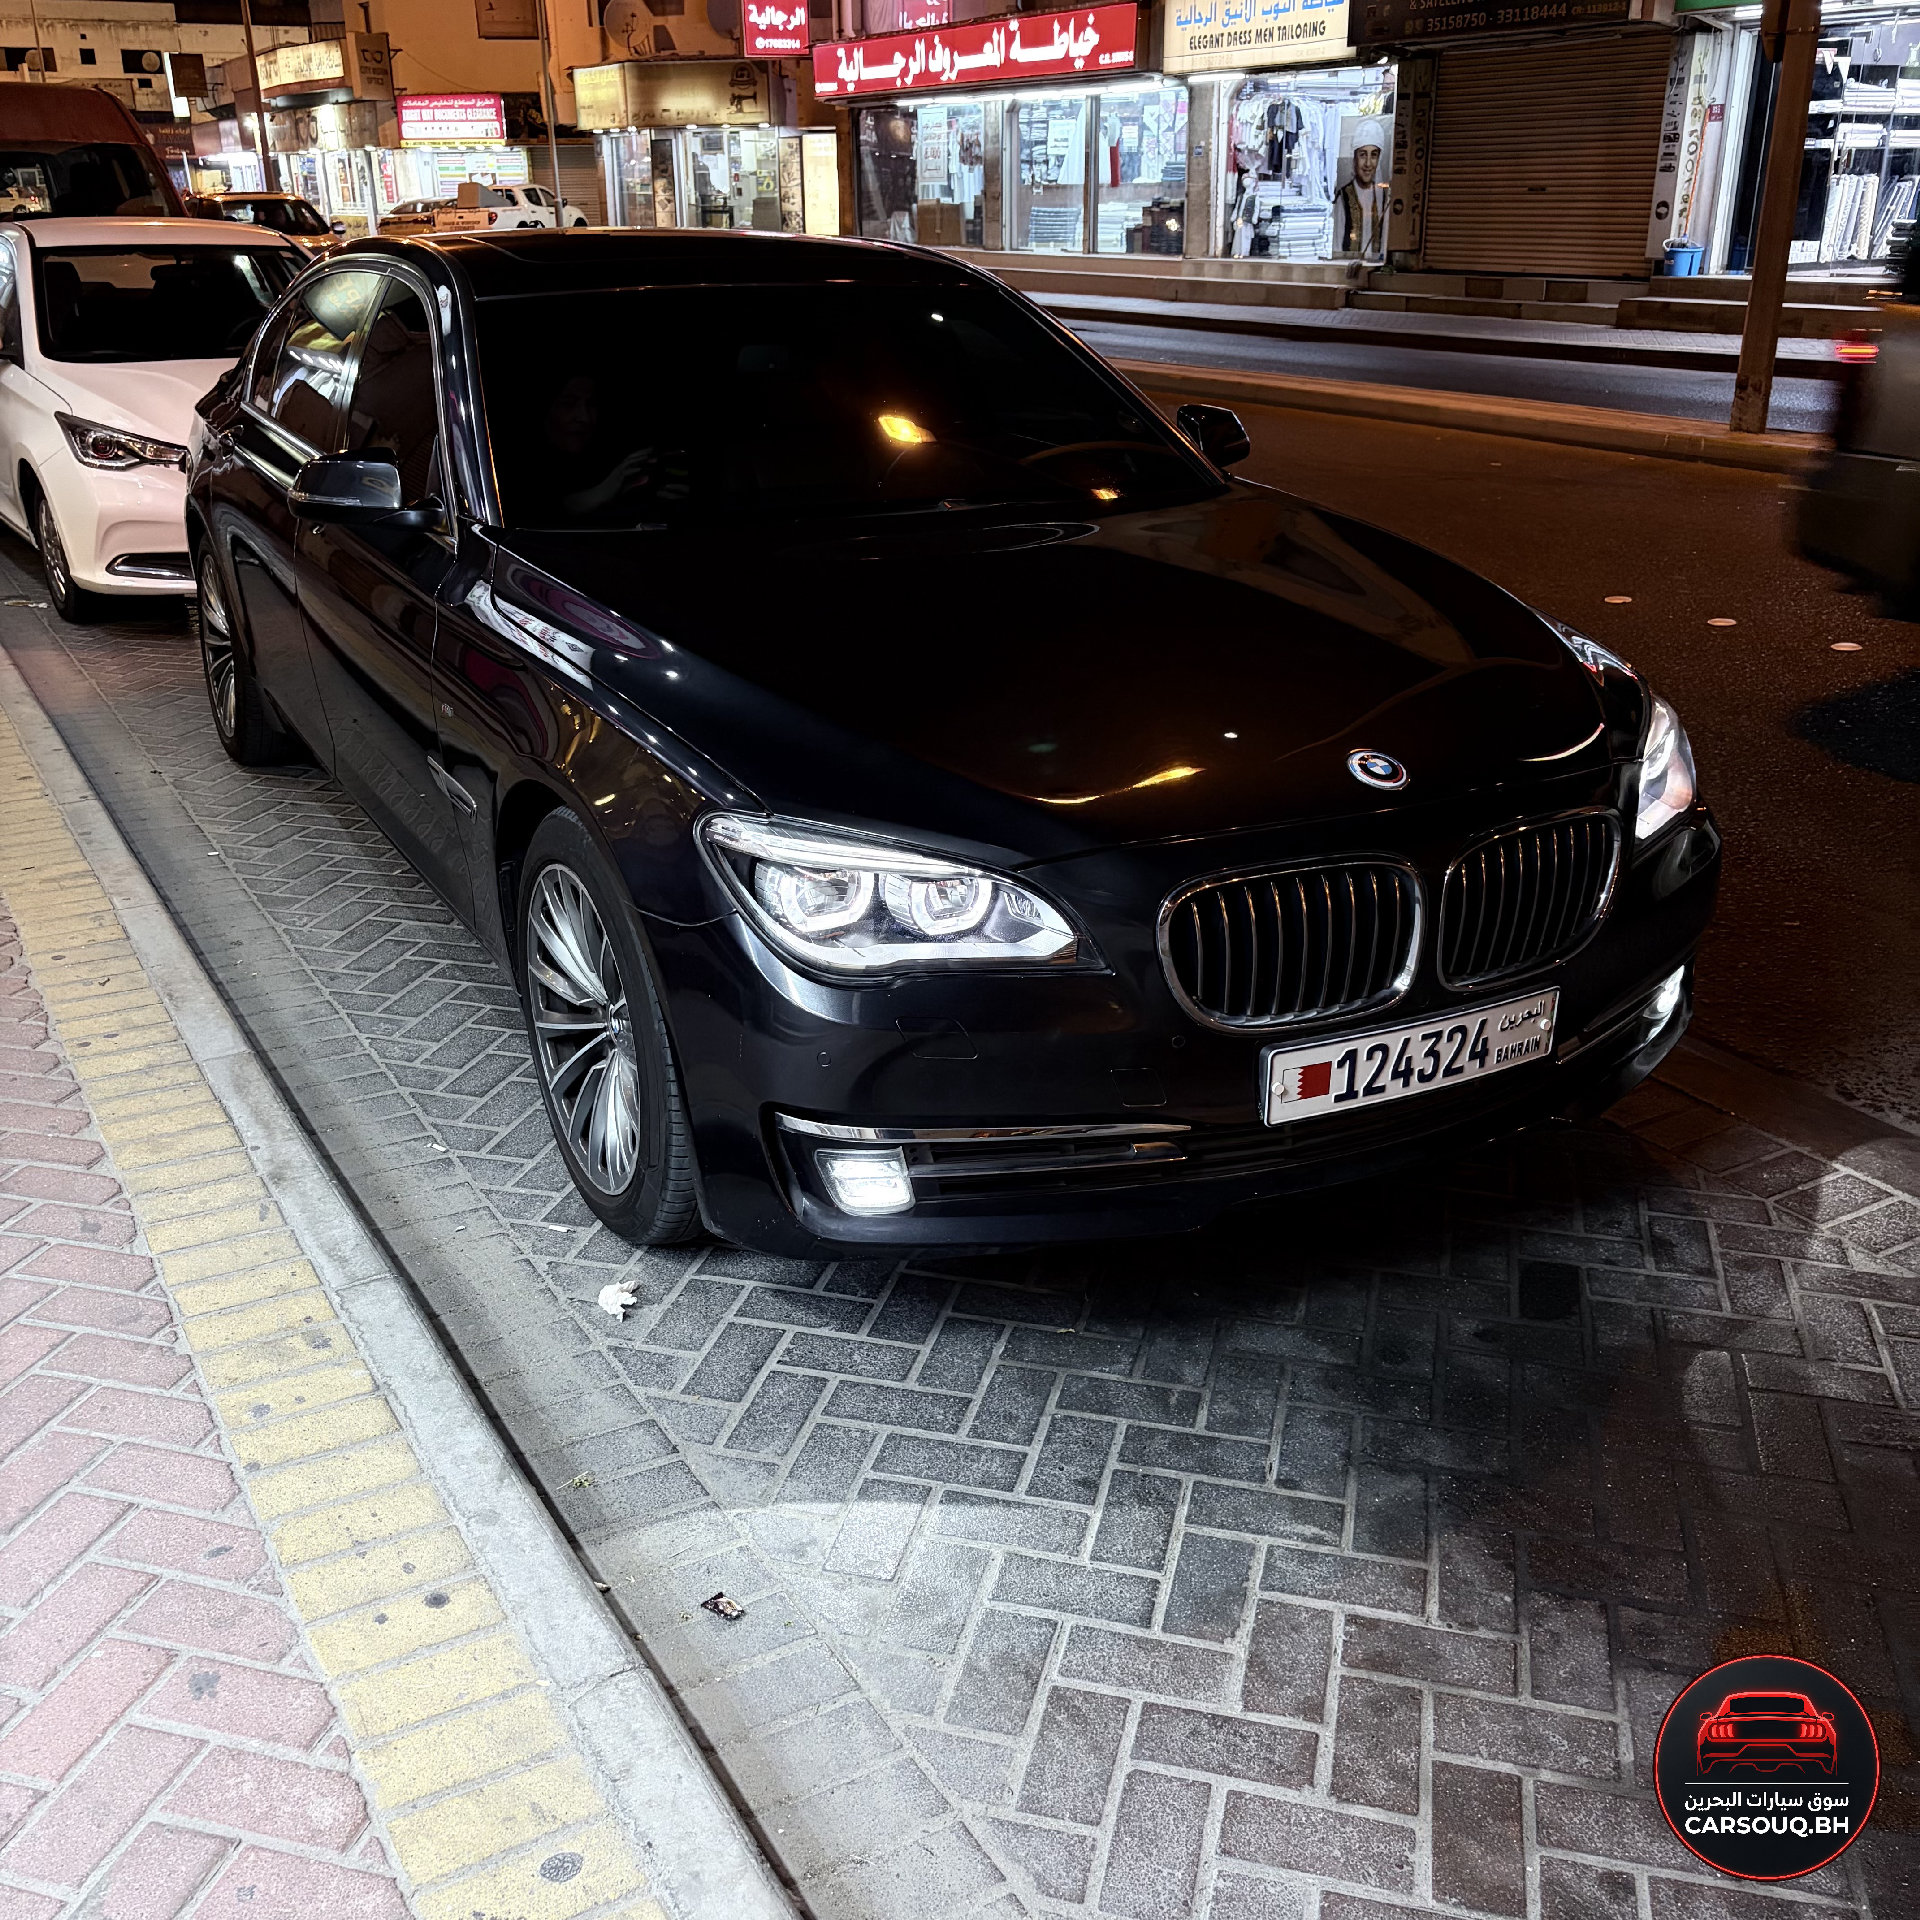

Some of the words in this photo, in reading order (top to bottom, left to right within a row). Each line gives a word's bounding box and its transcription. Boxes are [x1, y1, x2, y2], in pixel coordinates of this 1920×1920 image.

[748, 5, 805, 31] الرجالية
[1176, 2, 1217, 31] الرجالية
[1427, 13, 1487, 32] 35158750
[1496, 5, 1567, 24] 33118444
[1009, 13, 1100, 70] خياطة
[1189, 32, 1225, 50] ELEGANT
[1227, 30, 1251, 46] DRESS
[1255, 27, 1274, 43] MEN
[1278, 20, 1326, 41] TAILORING
[836, 38, 926, 92] الرجالية
[928, 26, 1006, 82] المعروف
[1499, 1000, 1545, 1031] البحرين
[1332, 1017, 1490, 1103] 124324
[1495, 1036, 1541, 1065] BAHRAIN
